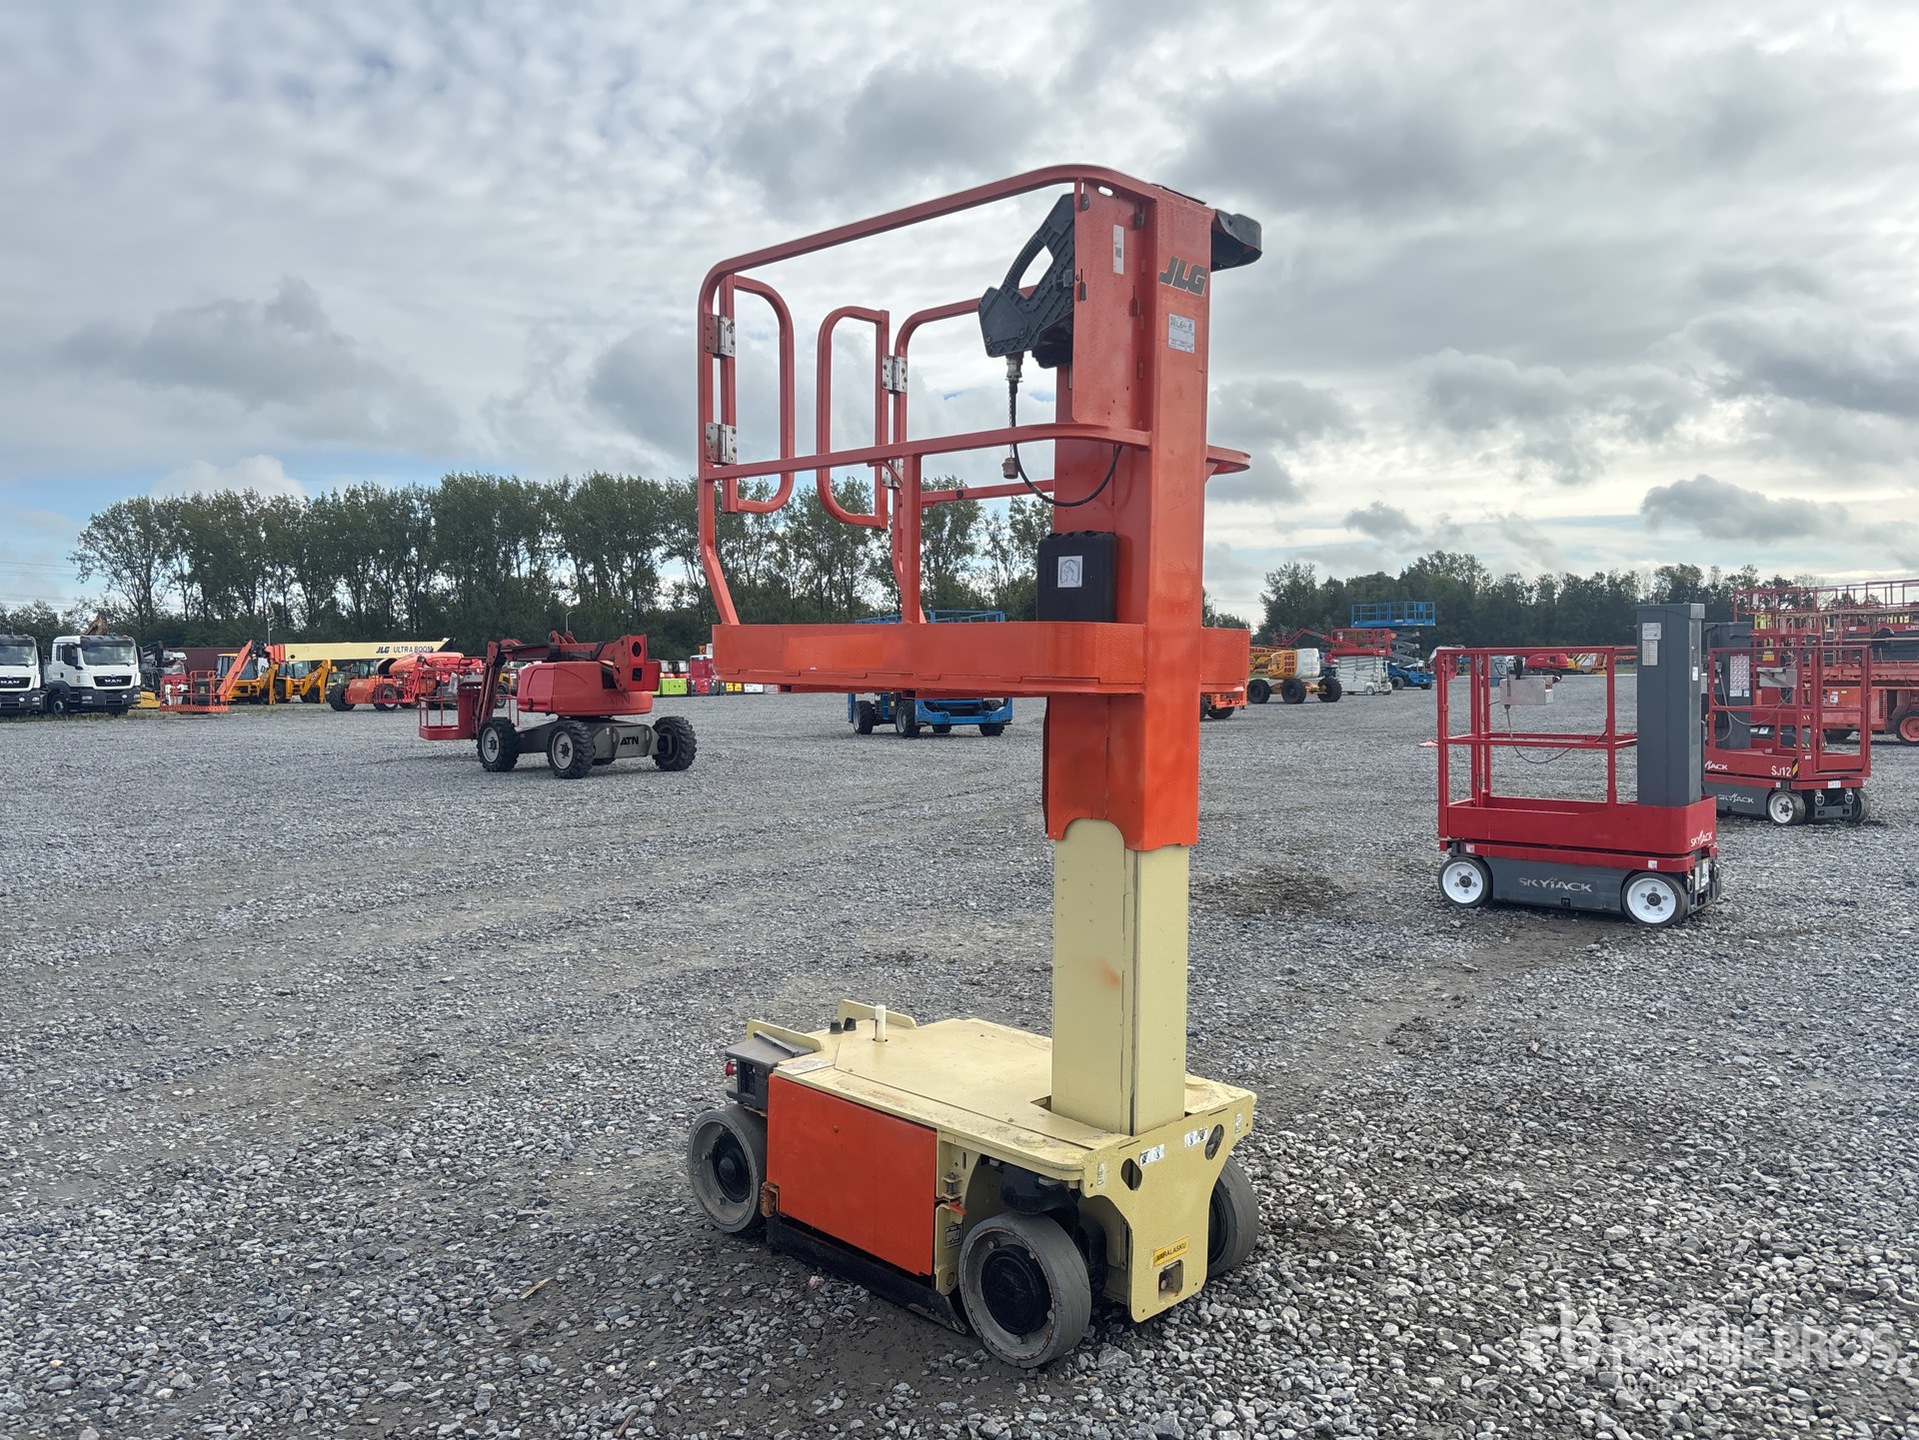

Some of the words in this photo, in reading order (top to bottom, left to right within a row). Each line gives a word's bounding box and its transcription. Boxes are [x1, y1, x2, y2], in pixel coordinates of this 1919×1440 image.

[1158, 255, 1209, 297] JLG
[376, 646, 390, 654] JLG
[393, 646, 413, 654] ULTRA
[414, 645, 433, 653] BOOM
[620, 736, 639, 746] ATN
[1704, 760, 1728, 771] JACK
[1771, 765, 1792, 777] SJ12
[1718, 792, 1755, 804] SKYJACK
[1690, 830, 1713, 847] SKYJACK
[1518, 876, 1593, 893] SKYJACK
